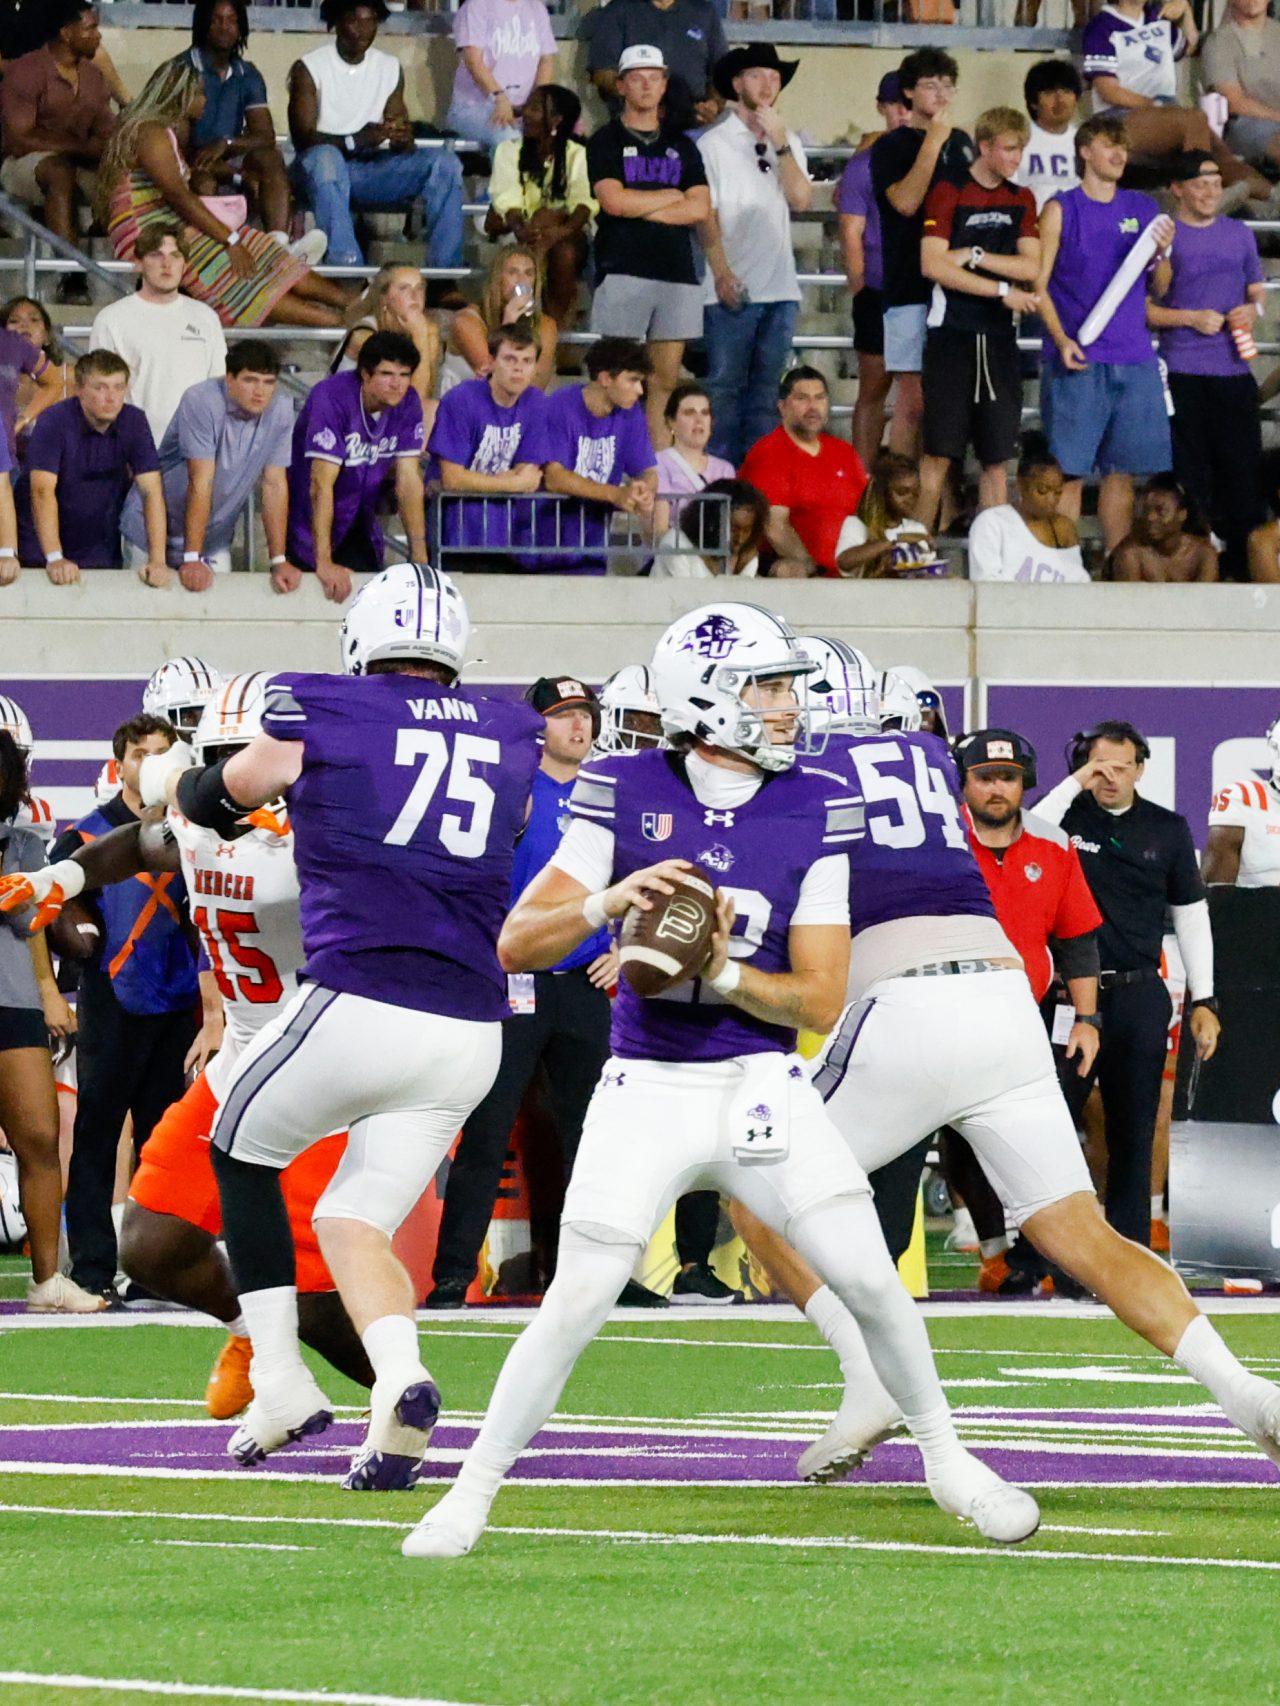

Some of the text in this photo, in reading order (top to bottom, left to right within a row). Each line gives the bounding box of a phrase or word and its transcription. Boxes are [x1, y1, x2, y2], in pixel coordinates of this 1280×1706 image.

[1124, 27, 1164, 47] ACU
[1028, 154, 1077, 178] AC
[406, 697, 479, 723] VANN
[383, 728, 501, 859] 75
[848, 741, 969, 851] 54
[1070, 834, 1101, 853] Bears
[697, 850, 734, 872] ACU
[194, 869, 255, 901] MERCER
[194, 906, 284, 1004] 15
